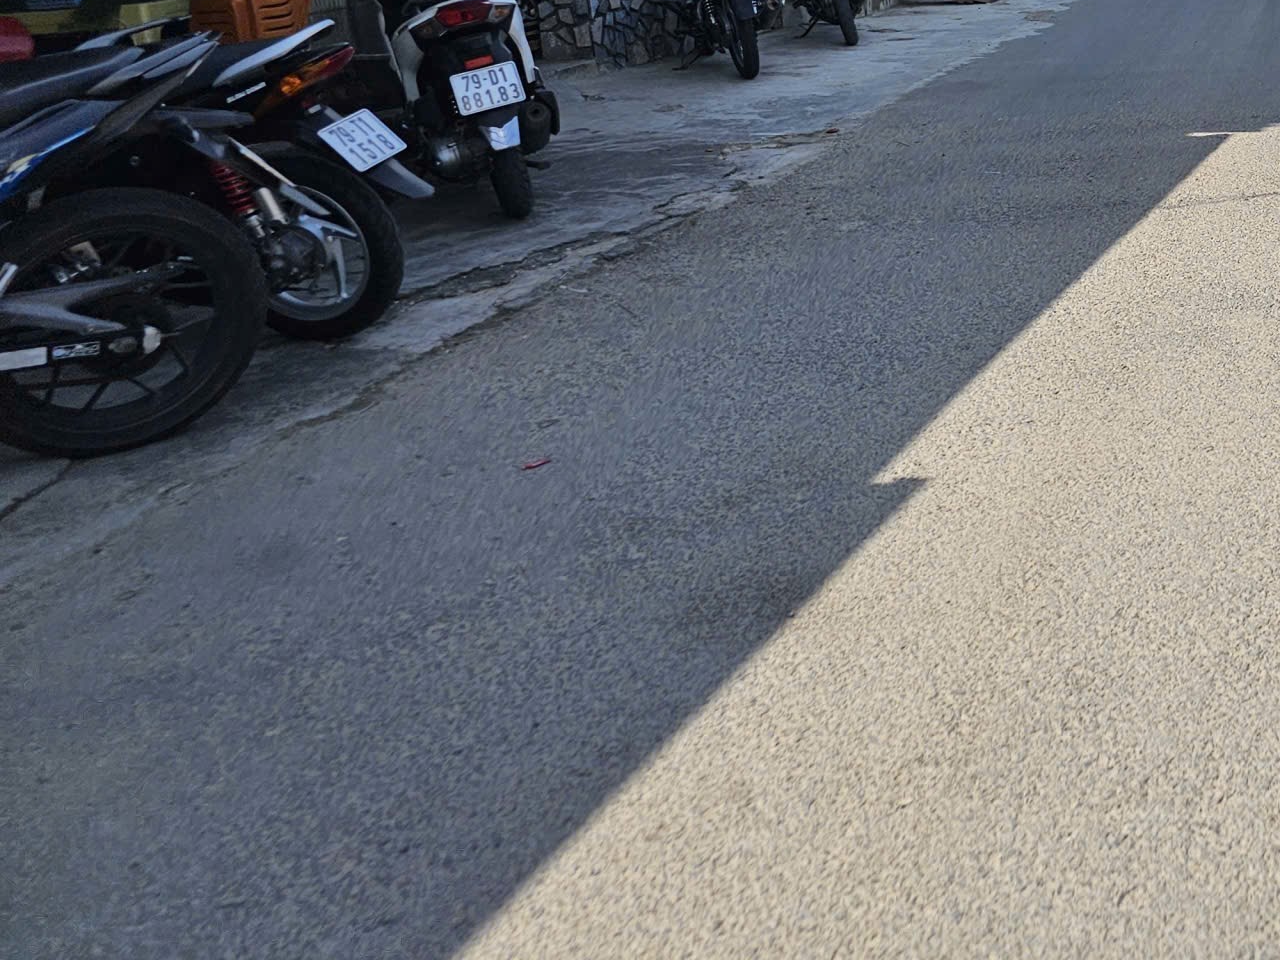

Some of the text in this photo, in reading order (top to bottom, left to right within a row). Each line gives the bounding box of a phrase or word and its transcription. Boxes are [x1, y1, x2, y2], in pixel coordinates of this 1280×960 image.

[461, 67, 508, 92] 79-D1
[461, 83, 521, 111] 881.83
[349, 133, 395, 165] 1518
